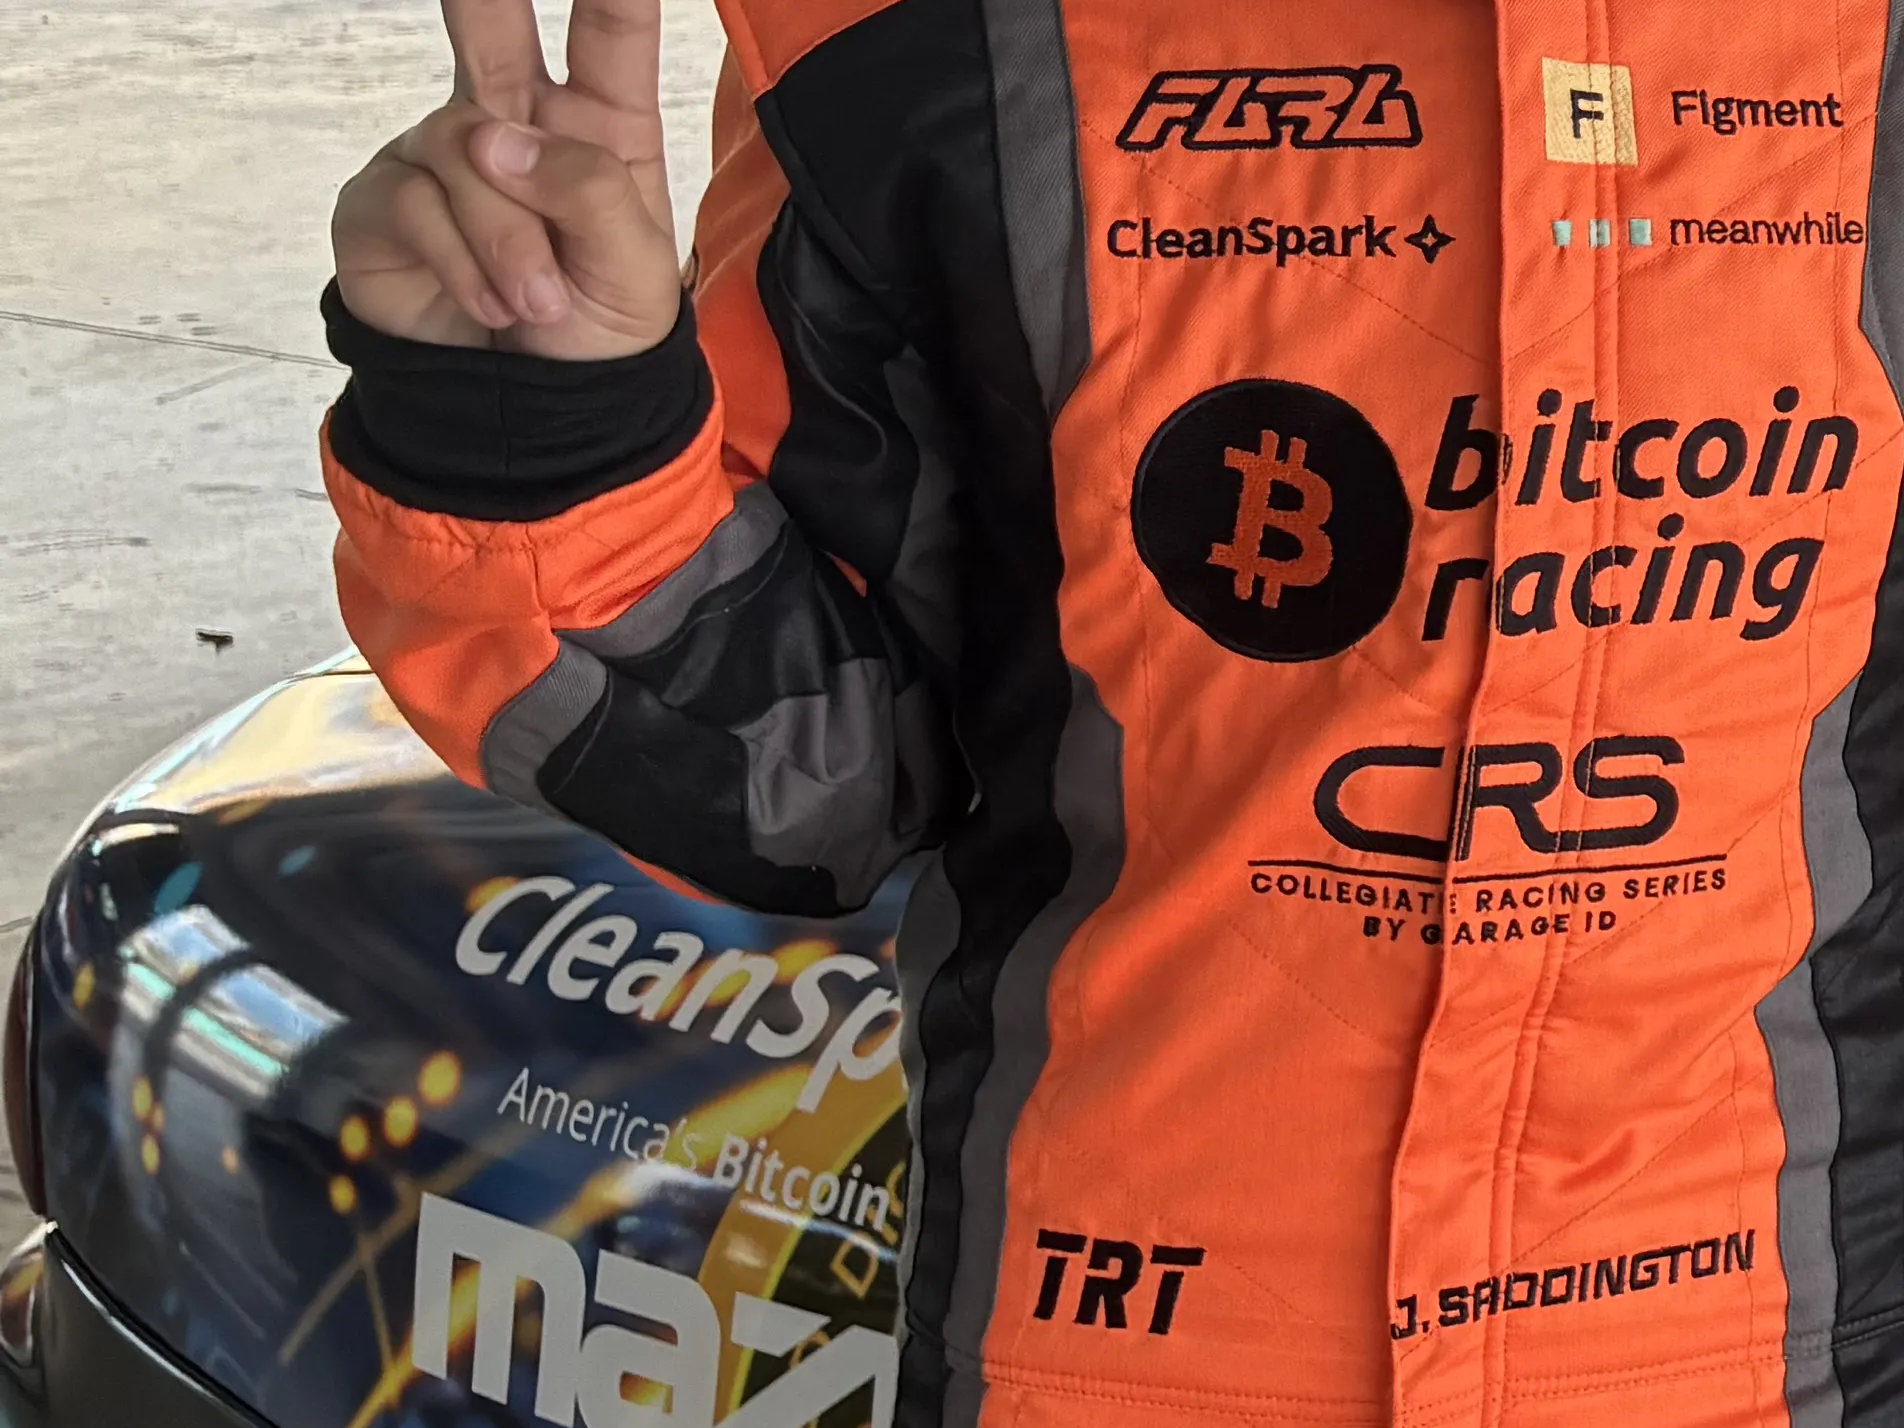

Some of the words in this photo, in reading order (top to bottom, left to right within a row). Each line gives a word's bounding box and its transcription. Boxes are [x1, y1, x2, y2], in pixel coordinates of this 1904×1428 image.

[1569, 89, 1604, 139] F
[1107, 215, 1397, 268] CleanSpark
[1669, 212, 1864, 245] meanwhile
[1425, 388, 1858, 512] bitcoin
[1420, 514, 1828, 642] racing
[1313, 735, 1685, 862] CRS
[1250, 871, 1459, 915] COLLEGIATE
[1475, 879, 1607, 912] RACING
[1623, 868, 1727, 903] SERIES
[1361, 916, 1403, 943] BY
[1420, 914, 1573, 947] GARAGE
[1584, 910, 1618, 933] ID
[496, 1067, 701, 1179] America's
[712, 1133, 892, 1233] Bitcoin
[1033, 1228, 1206, 1336] TRT
